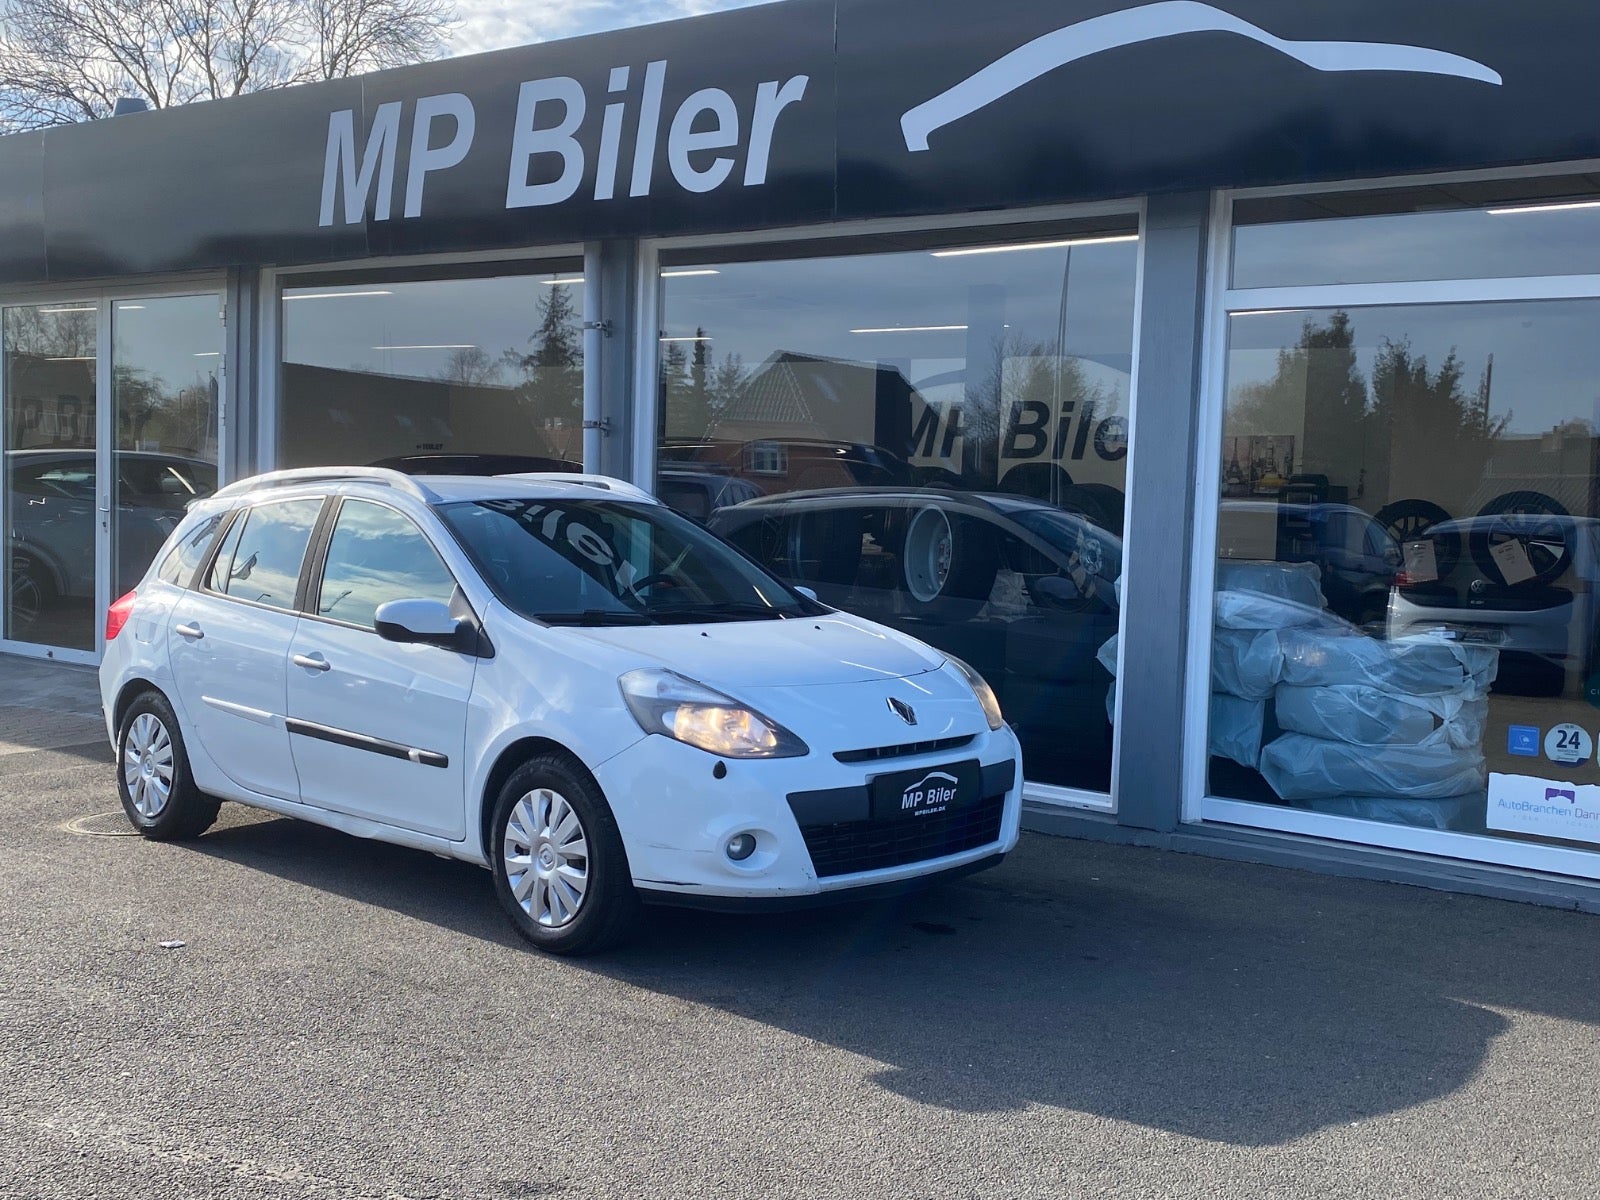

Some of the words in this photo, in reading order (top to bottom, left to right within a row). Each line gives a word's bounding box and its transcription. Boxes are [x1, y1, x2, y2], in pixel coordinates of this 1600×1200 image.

[319, 92, 476, 227] MP
[505, 59, 809, 209] Biler
[1556, 729, 1581, 750] 24
[901, 791, 923, 809] MP
[926, 787, 957, 804] Biler
[1497, 798, 1571, 817] AutoBranchen
